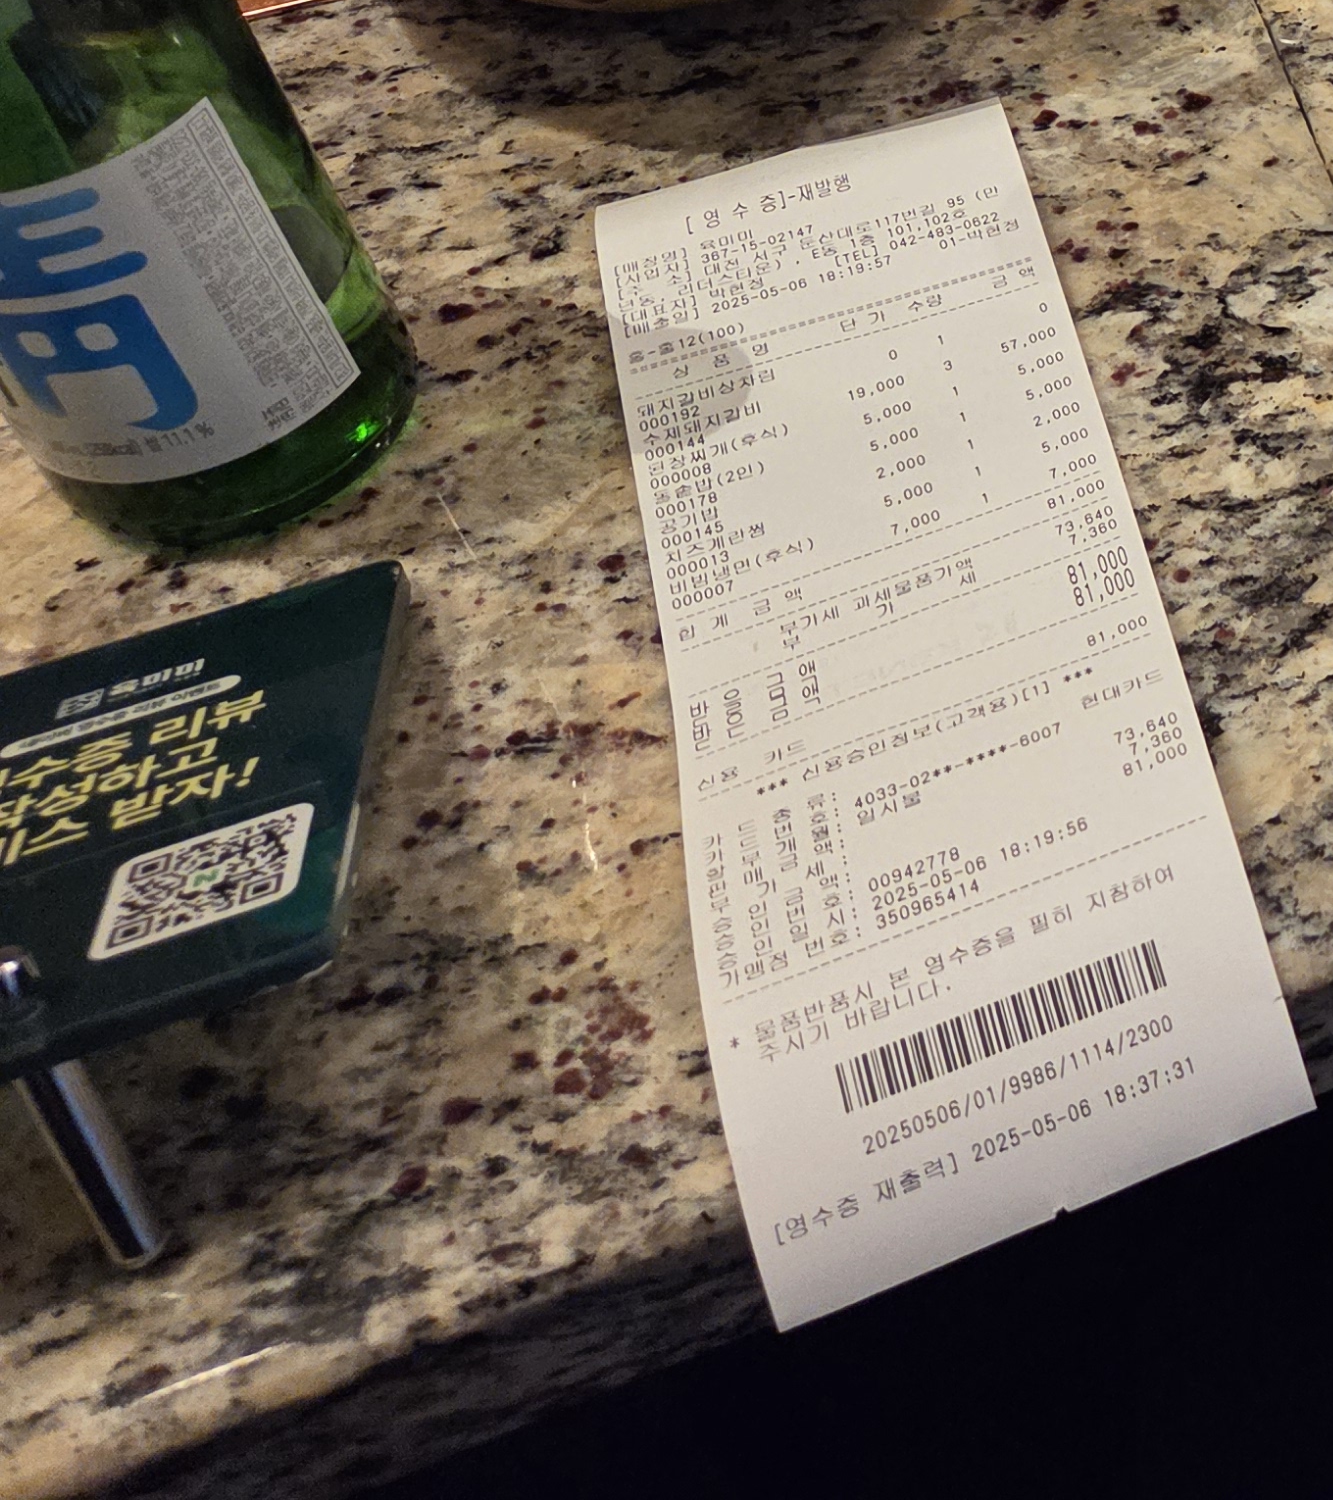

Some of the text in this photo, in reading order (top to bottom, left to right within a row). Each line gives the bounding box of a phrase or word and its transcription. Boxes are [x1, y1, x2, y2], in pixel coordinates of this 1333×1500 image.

[945, 193, 965, 209] 95
[698, 227, 754, 250] 육미미
[699, 223, 813, 265] 367-15-02147
[833, 243, 879, 268] [TEL]
[887, 210, 1000, 251] 042-483-0622
[709, 276, 808, 314] 2025-05-06
[817, 253, 891, 284] 18:19:57
[643, 325, 1057, 462] 000144 19,000 3 57,000
[637, 403, 701, 433] 000192
[648, 460, 712, 490] 000008
[861, 399, 912, 426] 5,000
[1016, 350, 1065, 376] 5,000
[654, 489, 719, 520] 000178
[868, 425, 919, 452] 5,000
[1024, 374, 1073, 401] 5,000
[659, 518, 725, 550] 000145
[874, 453, 926, 480] 2,000
[1031, 400, 1081, 428] 2,000
[1045, 477, 1105, 510] 81,000
[657, 504, 719, 535] 공기밥
[665, 548, 730, 581] 000013
[882, 480, 934, 508] 5,000
[1040, 426, 1089, 454] 5,000
[1053, 504, 1115, 536] 73,640
[670, 577, 734, 611] 000007
[888, 508, 941, 536] 7,000
[1047, 452, 1097, 480] 7,000
[1066, 517, 1118, 546] 7,360
[1065, 544, 1130, 586] 81,000
[1071, 566, 1136, 608] 81,000
[1085, 614, 1148, 648] 81,000
[148, 688, 268, 746] 리뷰
[1112, 710, 1178, 745] 73,640
[1127, 725, 1183, 756] 7,360
[1121, 741, 1188, 777] 81,000
[109, 756, 261, 831] 받자!
[867, 845, 961, 893] 00942778
[870, 815, 1088, 912] 2025-05-06 18:19:56
[874, 877, 980, 930] 350965414
[861, 1013, 1174, 1156] 20250506/01/9986/1114/2300
[970, 1097, 1092, 1163] 2025-05-06
[1102, 1055, 1195, 1108] 18:37:31
